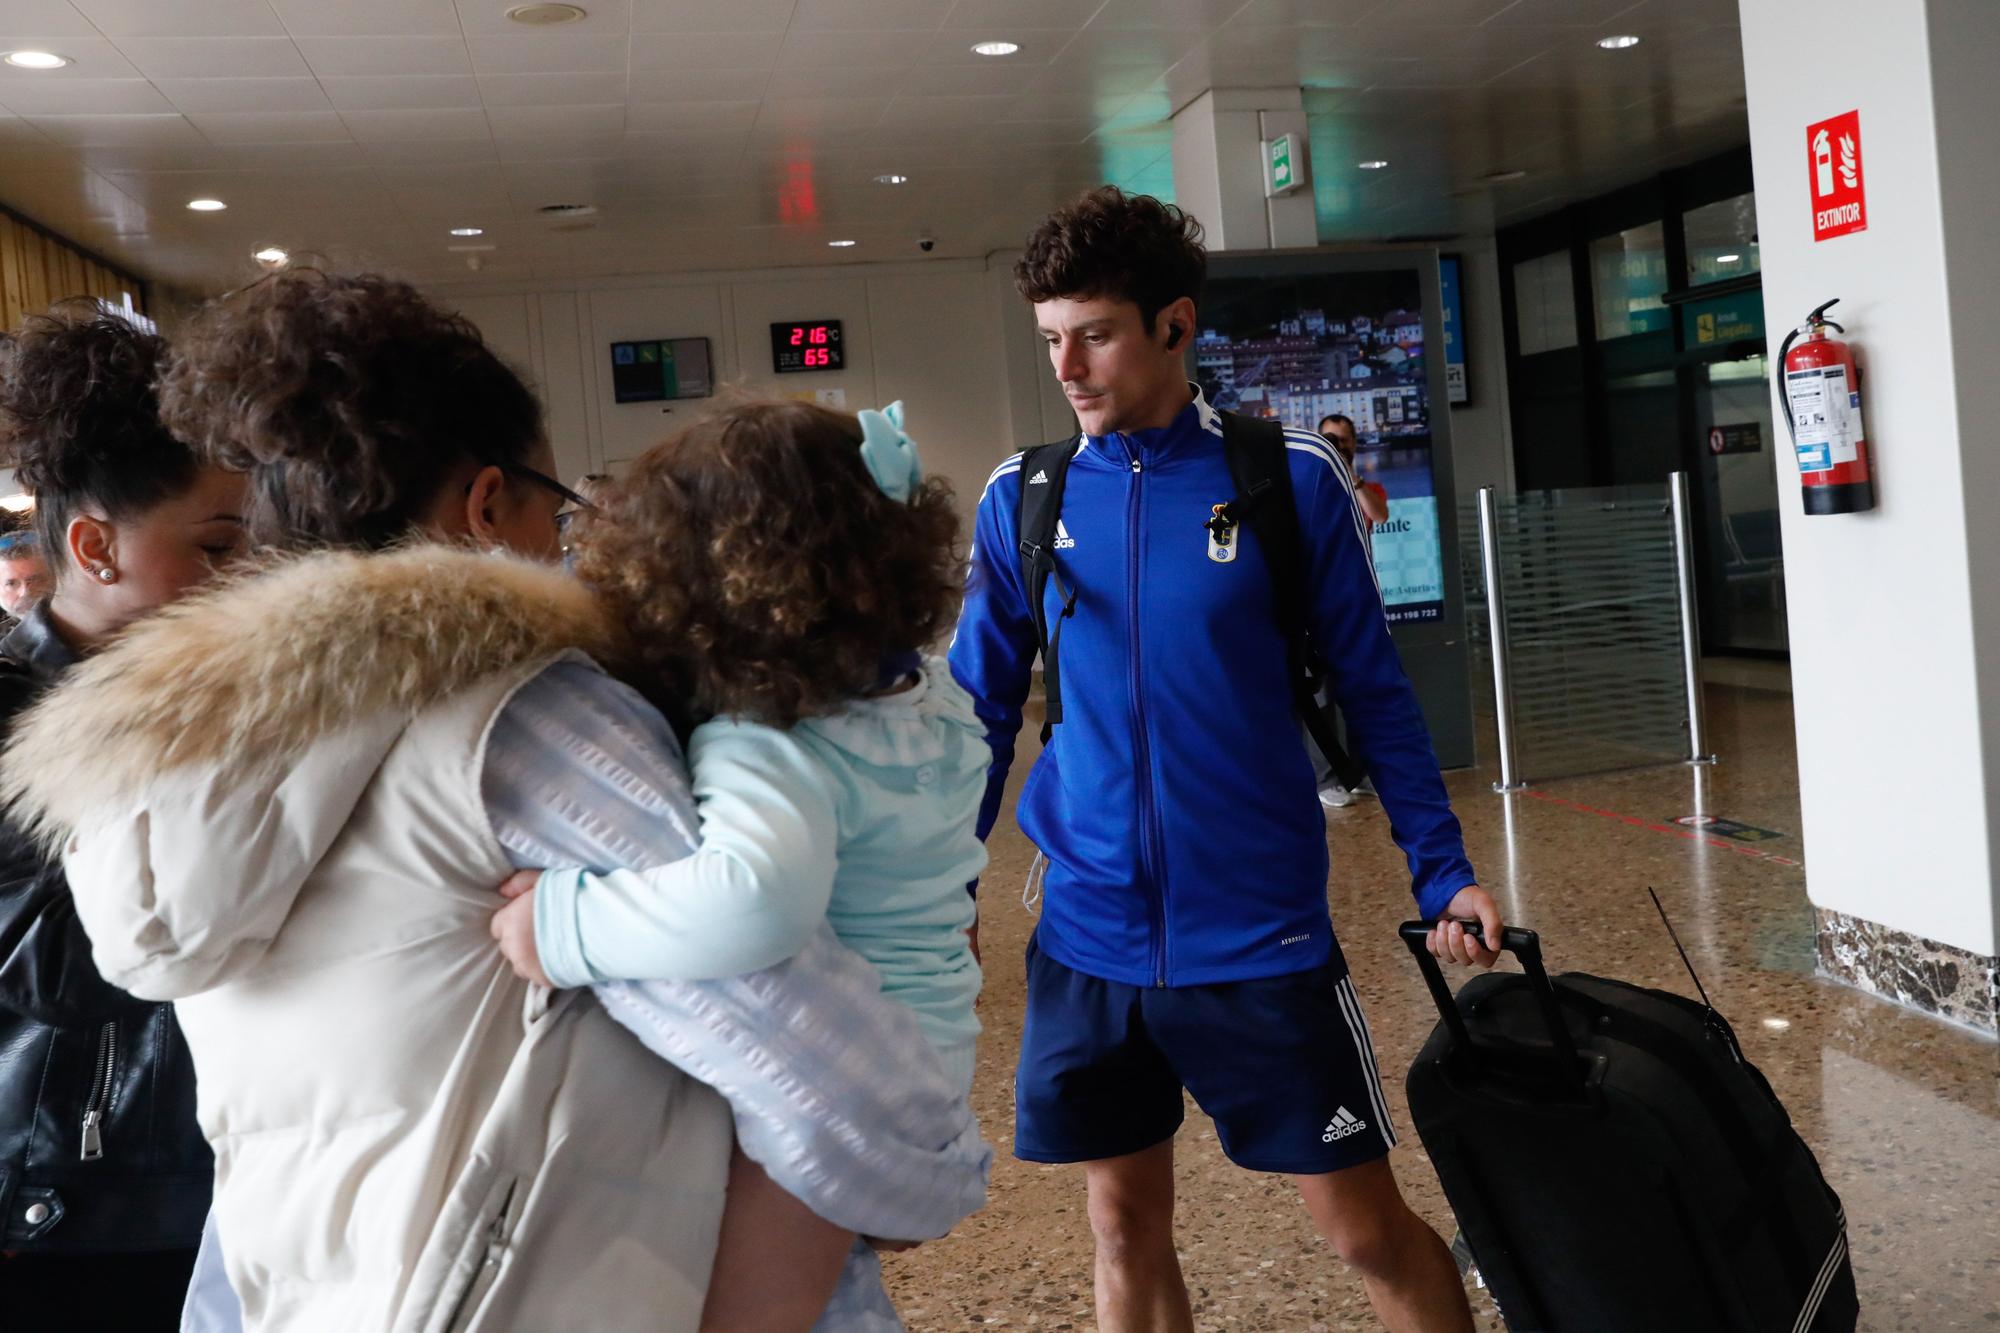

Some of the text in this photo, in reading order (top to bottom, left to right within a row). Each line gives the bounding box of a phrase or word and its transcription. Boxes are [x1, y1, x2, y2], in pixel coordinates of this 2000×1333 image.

[1273, 140, 1288, 161] EXIT
[1817, 202, 1861, 231] EXTINTOR
[804, 347, 829, 366] 65
[1029, 477, 1048, 485] adidas
[1053, 537, 1075, 549] das
[1322, 1120, 1367, 1143] adidas
